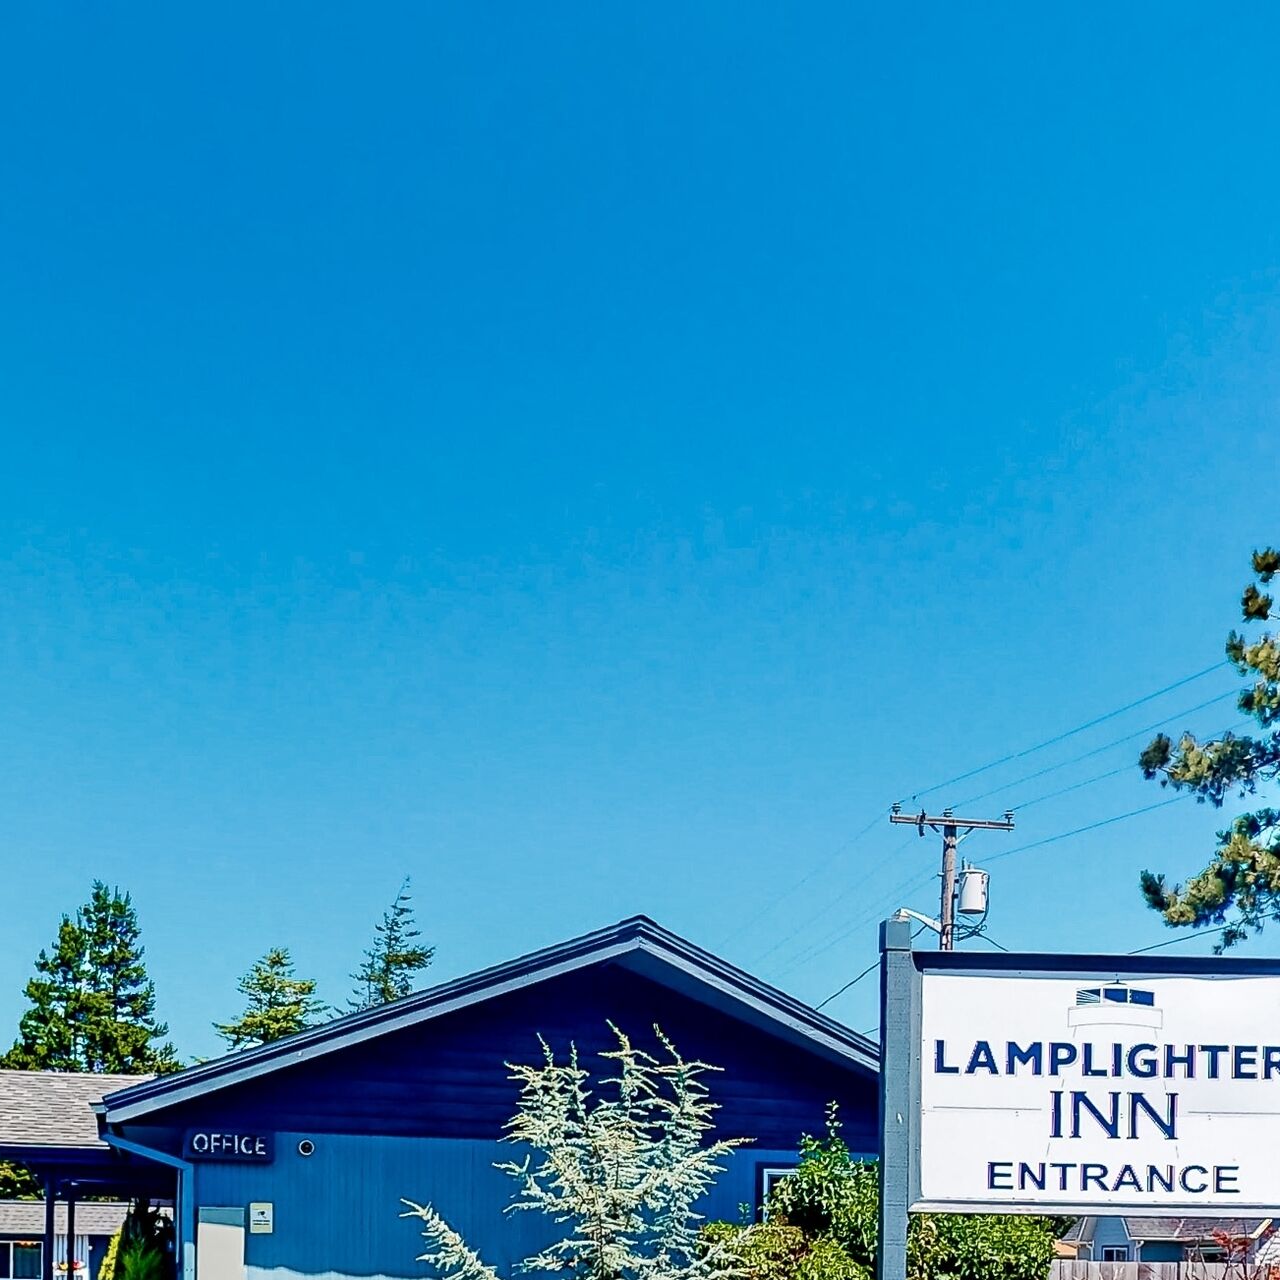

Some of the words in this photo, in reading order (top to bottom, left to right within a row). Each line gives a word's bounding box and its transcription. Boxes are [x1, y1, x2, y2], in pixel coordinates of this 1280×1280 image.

[1050, 1090, 1179, 1140] INN
[193, 1133, 266, 1155] OFFICE
[988, 1161, 1240, 1193] ENTRANCE
